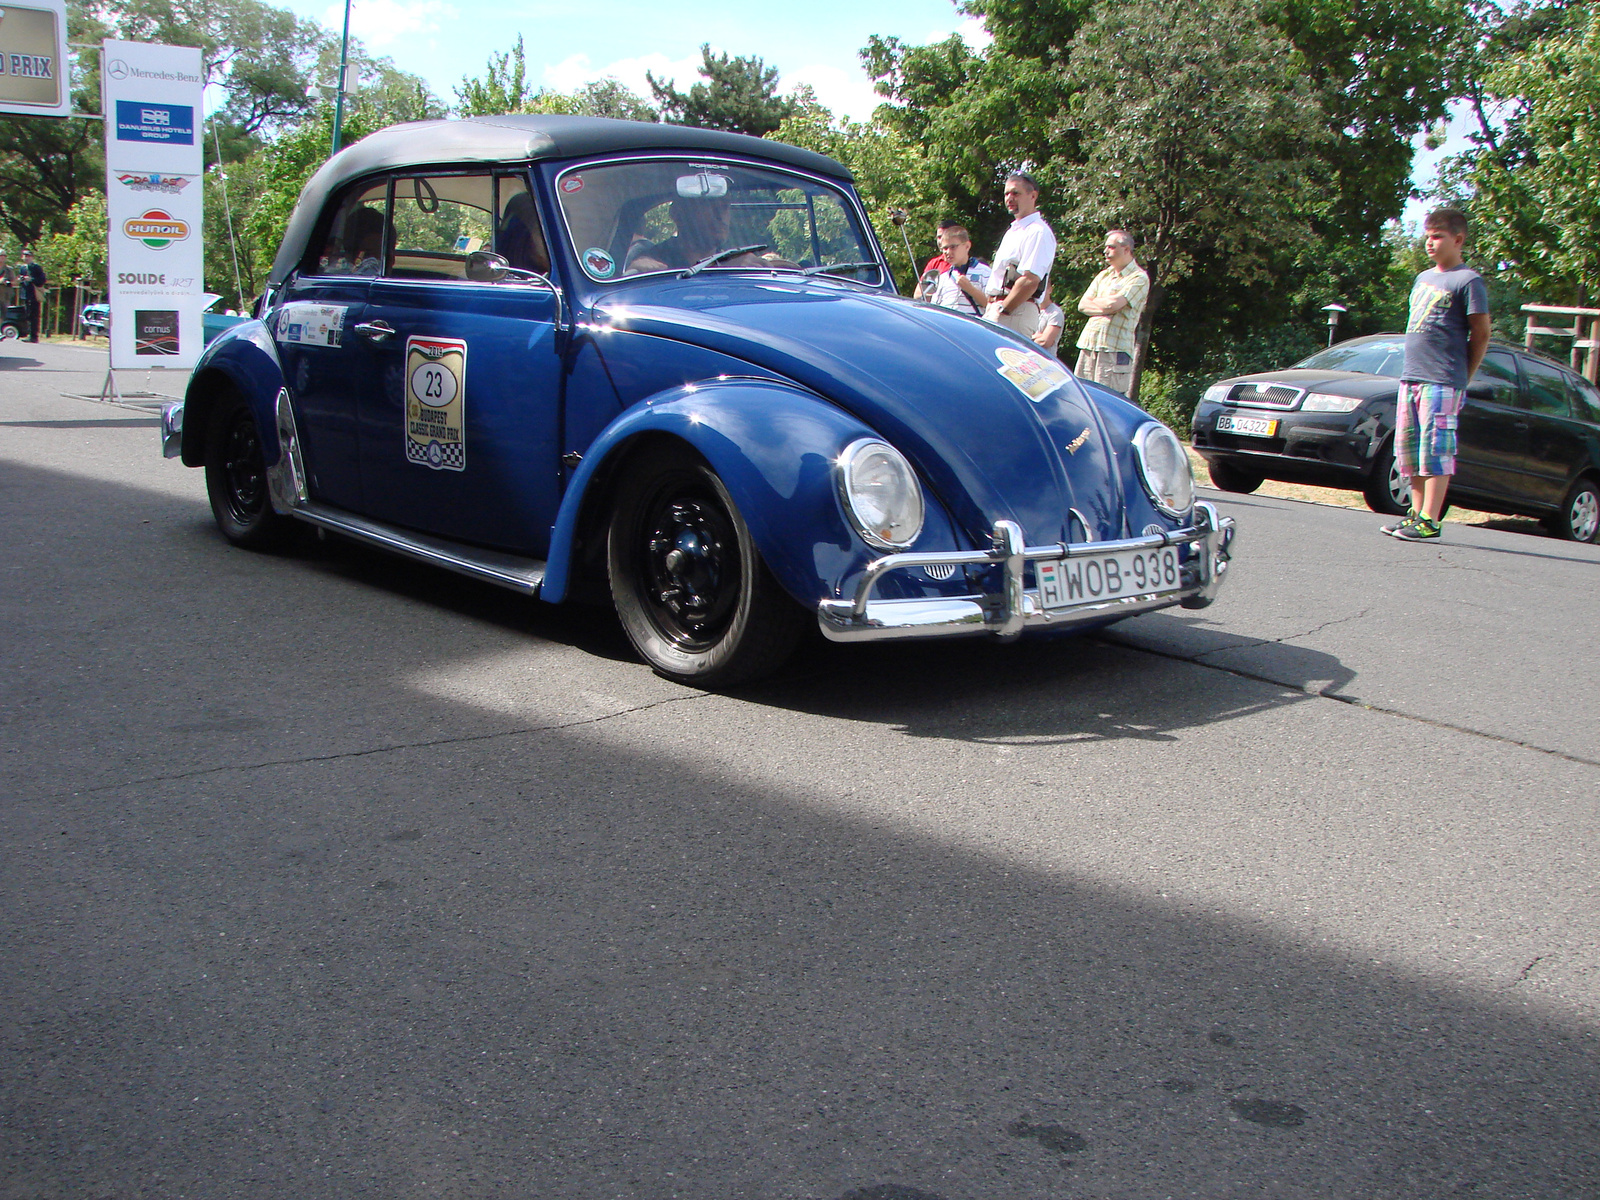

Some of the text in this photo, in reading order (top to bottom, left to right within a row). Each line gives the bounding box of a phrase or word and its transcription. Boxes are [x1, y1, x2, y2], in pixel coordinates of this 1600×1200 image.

[10, 54, 52, 79] PRIX
[130, 68, 199, 83] Mercedes-Benz
[119, 123, 192, 134] DANUBIUS HOTELS
[141, 131, 170, 139] GROUP
[118, 273, 165, 284] SOLIDE
[426, 371, 442, 398] 23
[420, 409, 447, 425] BUDAPEST
[410, 421, 459, 441] CLASSIC GRAND PRIX
[1219, 418, 1231, 429] BB
[1237, 419, 1267, 433] 04322
[1045, 551, 1175, 602] H WOB-938
